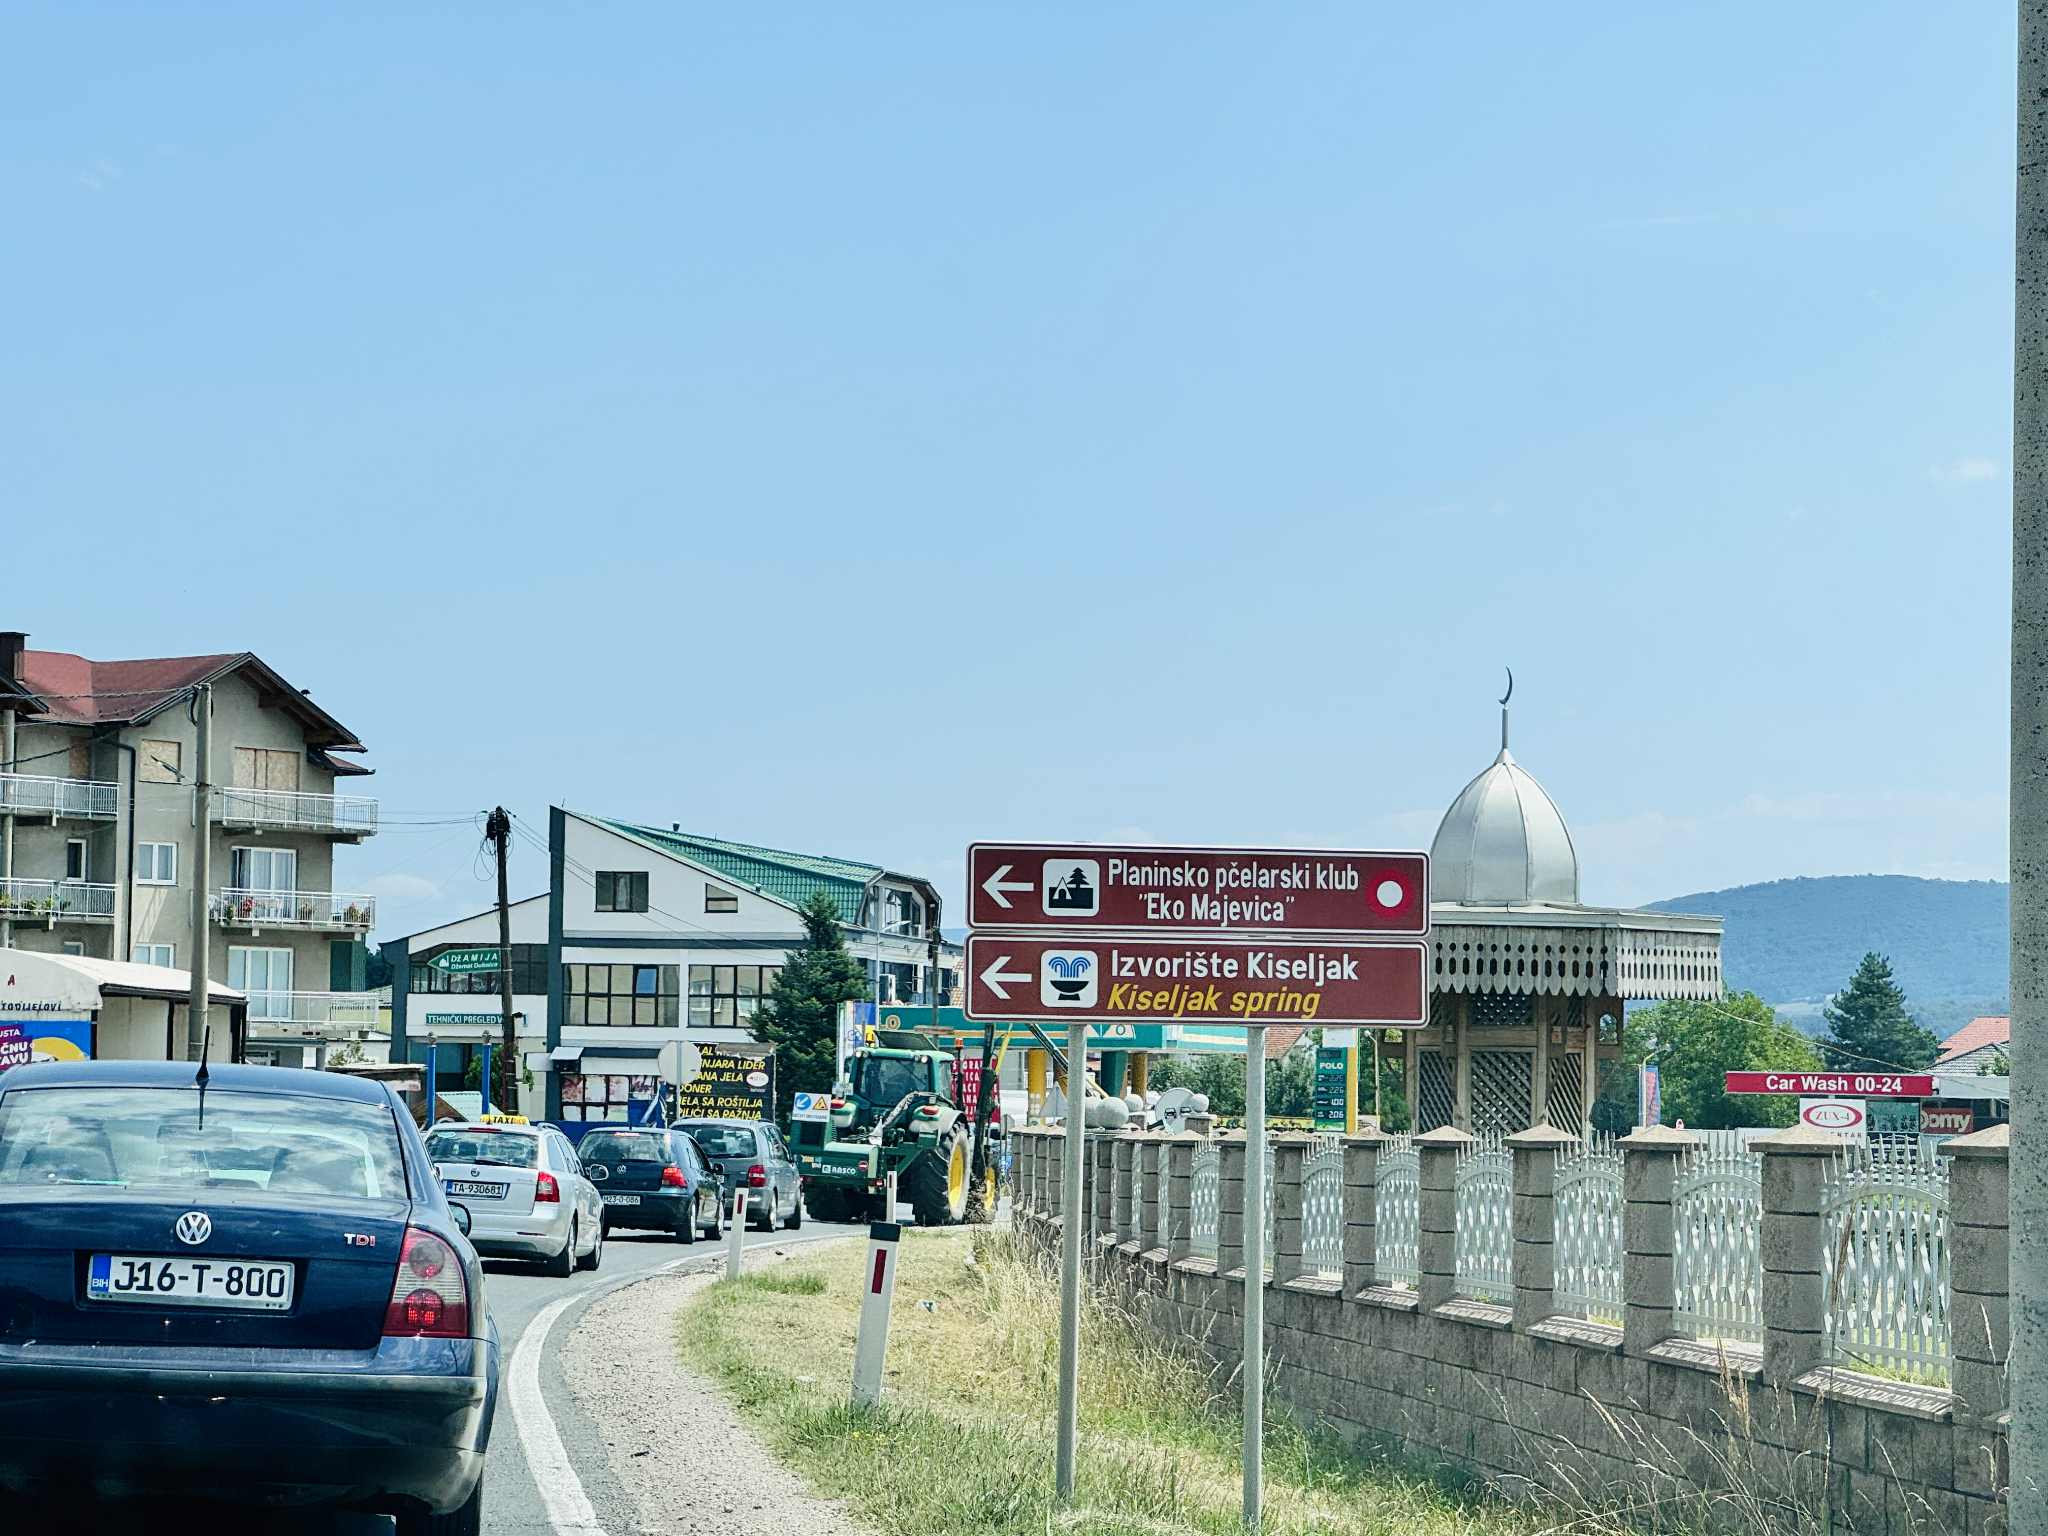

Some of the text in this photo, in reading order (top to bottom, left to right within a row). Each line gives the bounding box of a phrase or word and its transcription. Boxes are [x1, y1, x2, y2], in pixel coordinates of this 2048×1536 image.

[1108, 858, 1359, 895] Planinsko pčelarski klub
[1111, 949, 1359, 987] Izvorište Kiseljak
[1106, 983, 1321, 1019] Kiseljak spring
[463, 1015, 496, 1024] PREGLED
[737, 1060, 766, 1070] LIDER
[1319, 1062, 1344, 1070] POLO
[720, 1073, 744, 1082] JELA
[1766, 1075, 1902, 1092] Car Wash 00-24
[702, 1097, 714, 1106] SA
[717, 1096, 763, 1108] ROŠTILJA
[493, 1116, 514, 1124] TAXI
[707, 1109, 720, 1119] SA
[453, 1183, 502, 1195] TA-930681
[343, 1233, 376, 1247] TDI
